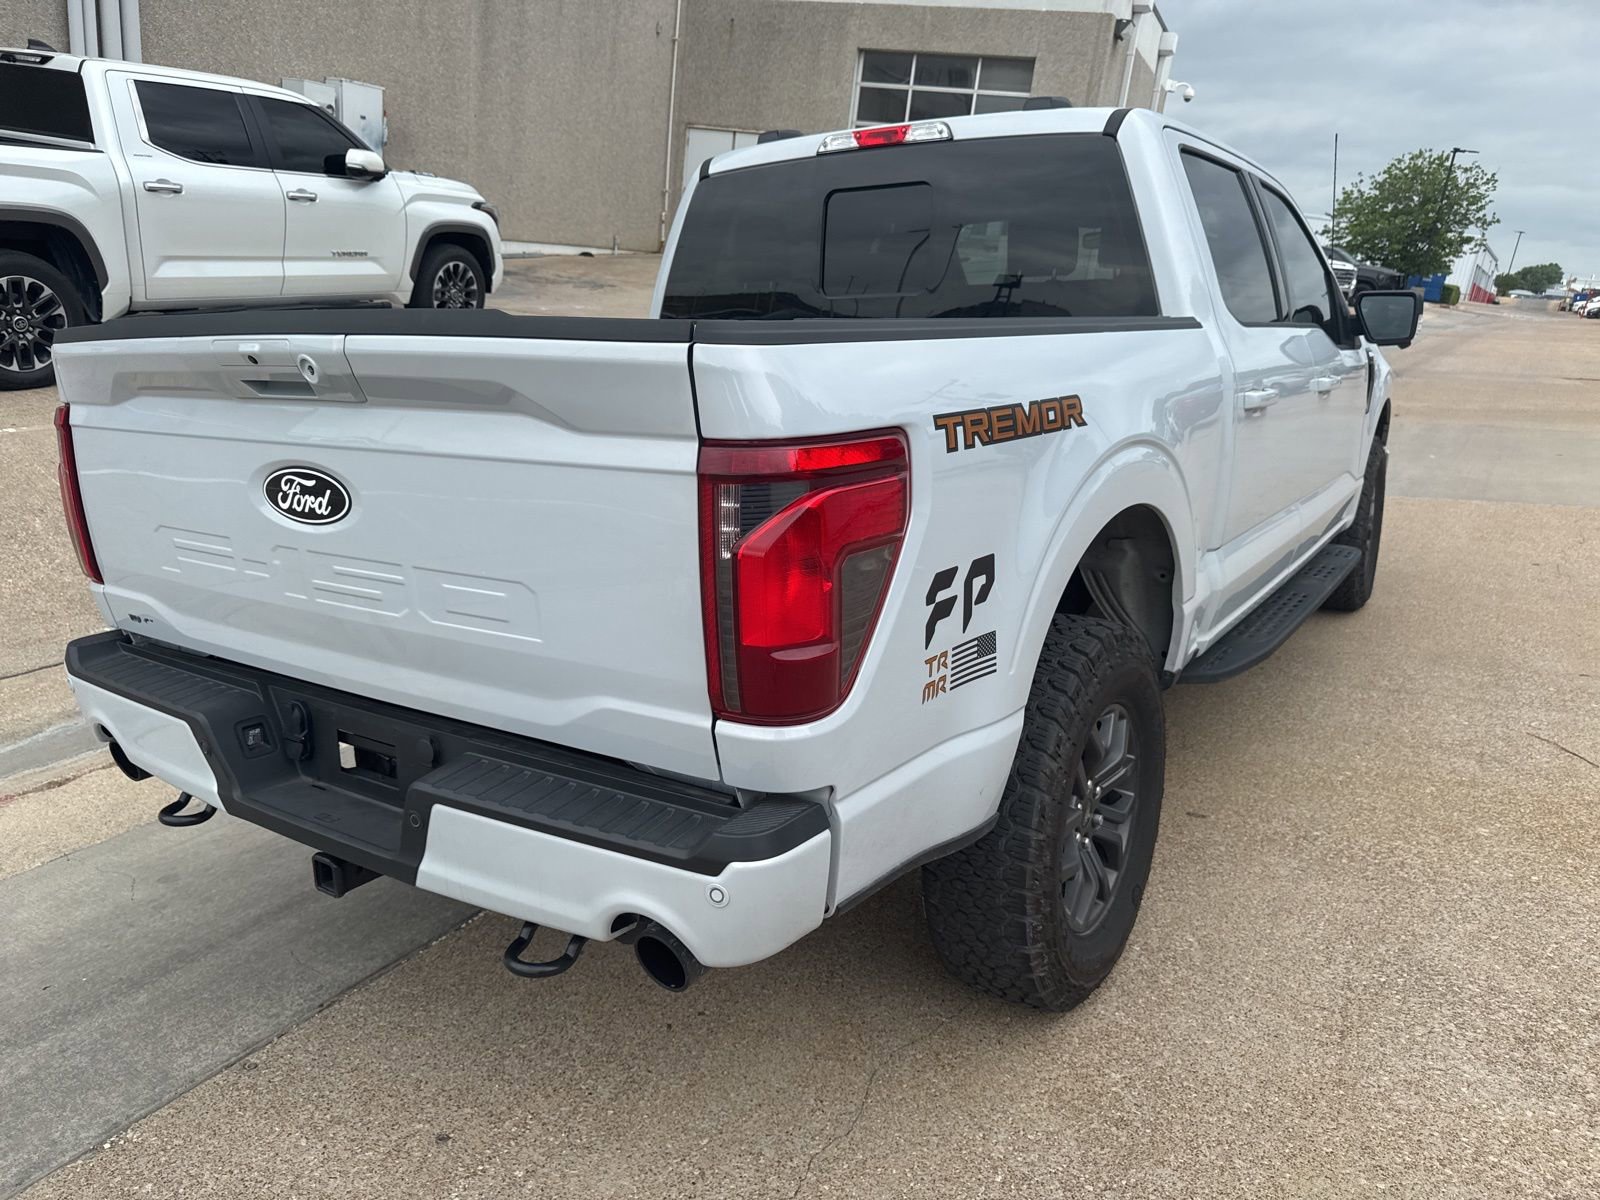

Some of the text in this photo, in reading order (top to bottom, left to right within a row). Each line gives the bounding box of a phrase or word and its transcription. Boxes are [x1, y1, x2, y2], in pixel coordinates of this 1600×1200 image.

[933, 394, 1088, 453] TREMOR
[277, 475, 332, 516] Ford
[925, 553, 995, 650] FP
[924, 650, 948, 677] TR
[921, 674, 947, 704] MR
